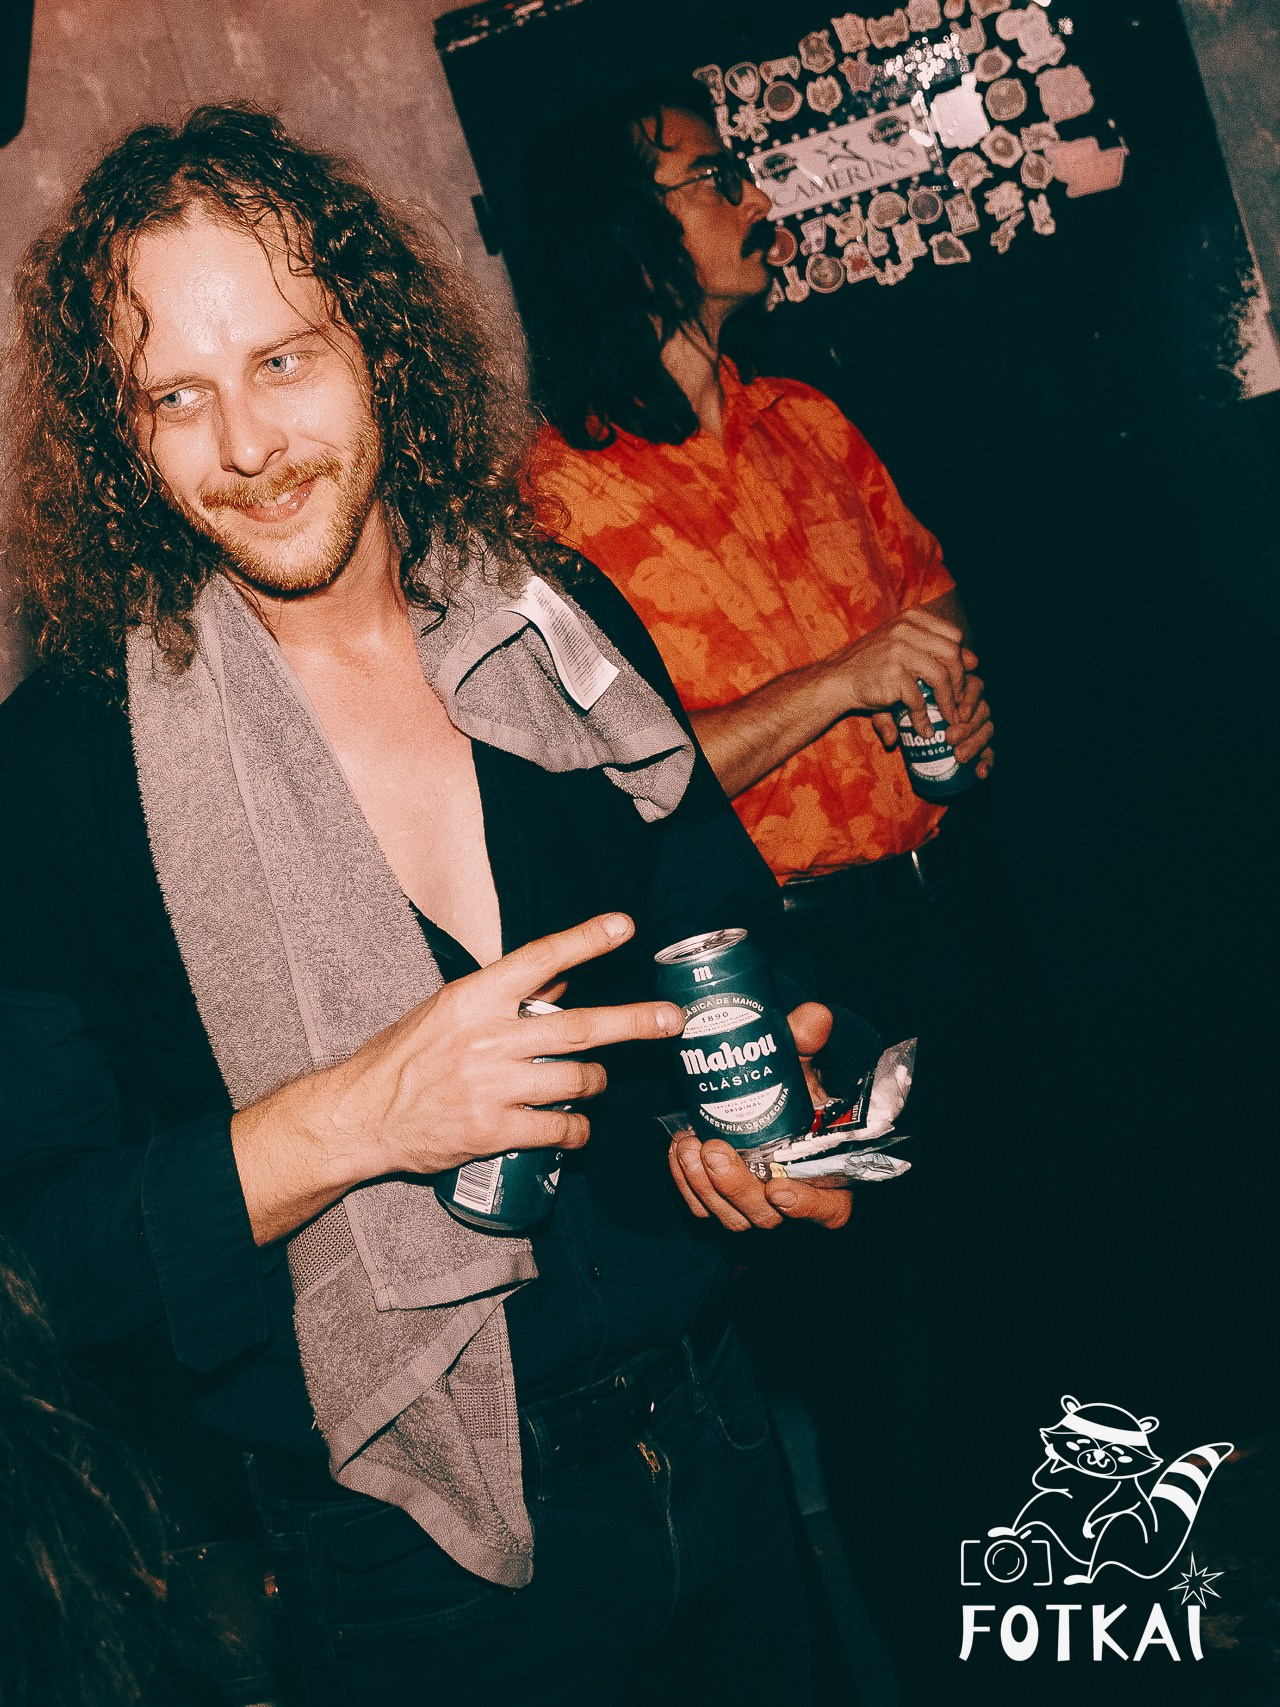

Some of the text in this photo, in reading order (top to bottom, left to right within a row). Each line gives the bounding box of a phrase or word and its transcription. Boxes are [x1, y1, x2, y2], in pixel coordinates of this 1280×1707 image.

[772, 149, 917, 208] CAMERINO
[701, 1011, 729, 1023] 1890
[732, 997, 765, 1012] MAHOU
[680, 1033, 777, 1075] Mahou
[699, 1066, 773, 1092] CLÁSICA
[724, 1101, 762, 1114] ORIGINAL
[744, 1088, 789, 1129] CERVECERA
